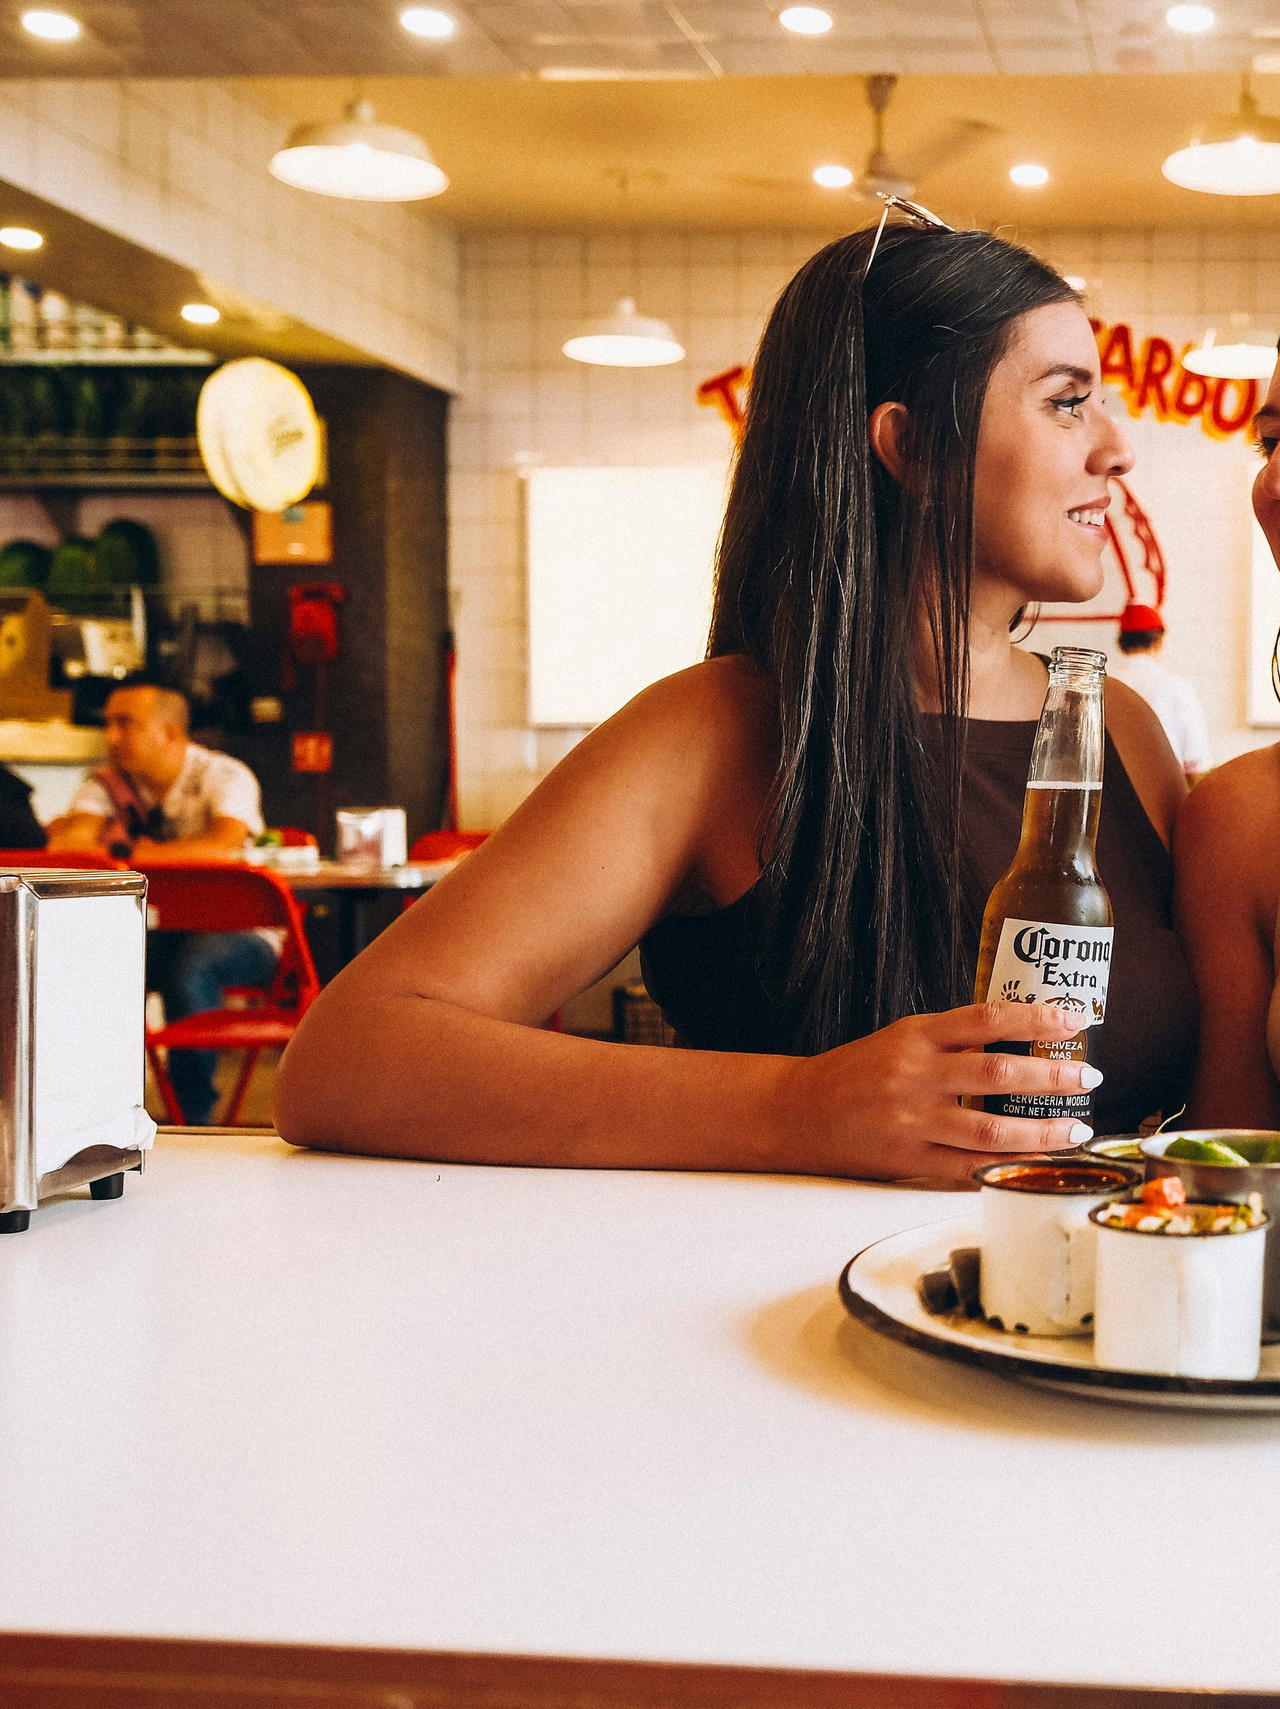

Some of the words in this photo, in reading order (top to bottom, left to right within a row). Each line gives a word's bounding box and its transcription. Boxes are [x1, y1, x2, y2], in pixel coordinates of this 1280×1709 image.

[1089, 318, 1258, 440] ARBO
[1013, 926, 1111, 969] Corona
[1041, 961, 1097, 988] Extra
[1037, 1040, 1084, 1051] CERVEZA
[1049, 1050, 1072, 1060] MAS
[1010, 1094, 1063, 1107] CERVECERIA
[1065, 1095, 1091, 1107] MODELO
[1003, 1103, 1026, 1115] CONT.
[1028, 1106, 1046, 1117] NET.
[1047, 1108, 1061, 1117] 355
[1061, 1109, 1070, 1117] ml
